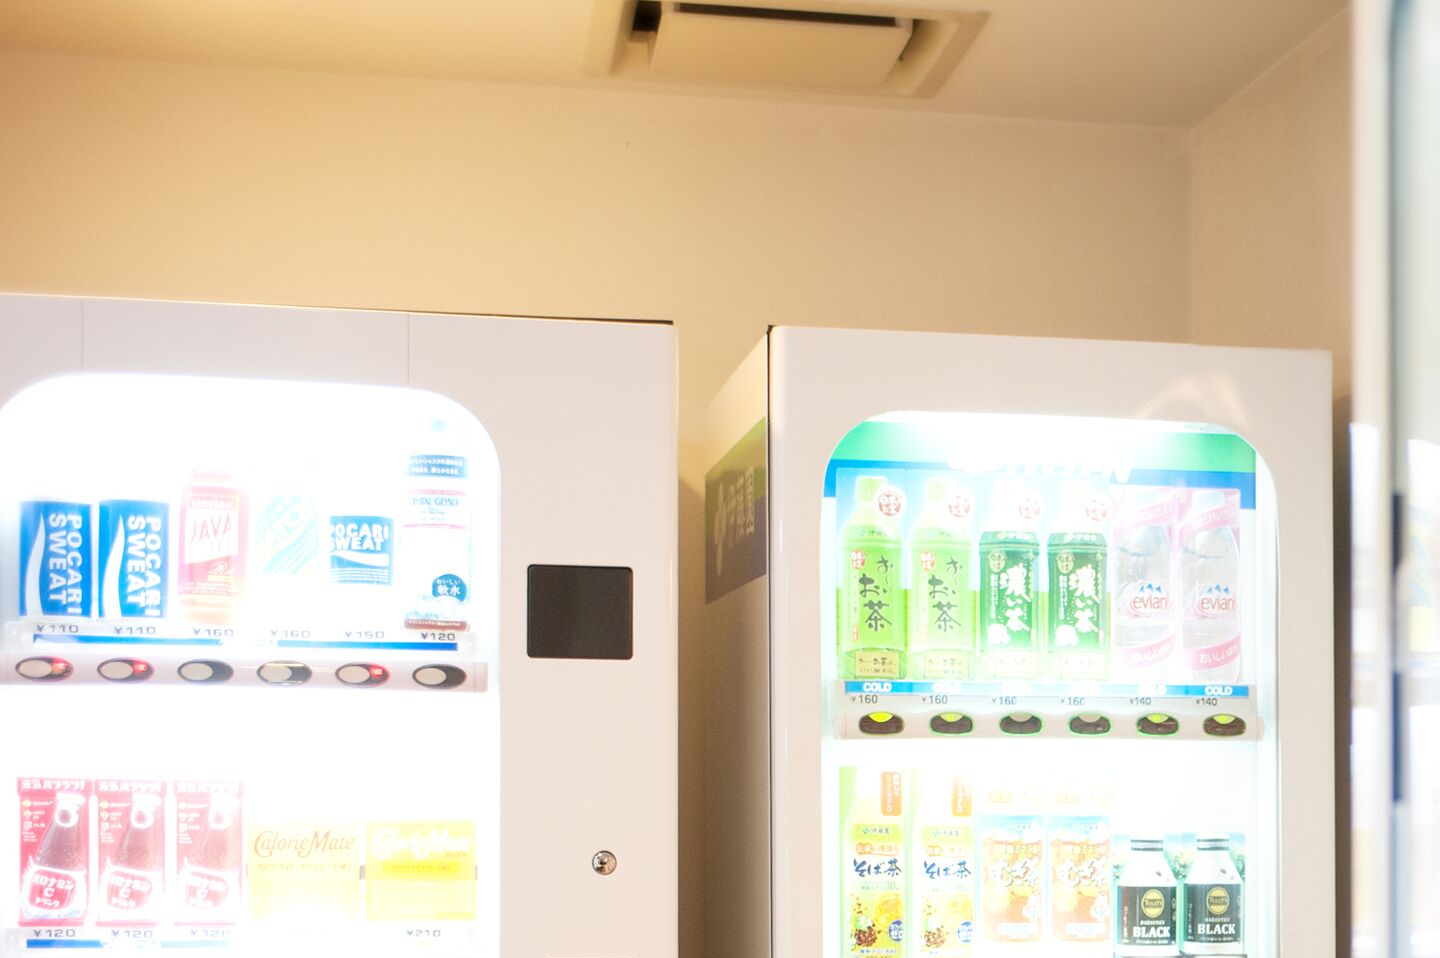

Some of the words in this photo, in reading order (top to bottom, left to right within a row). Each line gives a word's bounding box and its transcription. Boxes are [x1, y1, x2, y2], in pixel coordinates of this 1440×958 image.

[190, 513, 232, 543] JAVA
[49, 513, 67, 605] SWEAT
[66, 514, 82, 614] POCARI
[127, 515, 146, 607] SWEAT
[145, 516, 161, 617] POCARI
[1133, 595, 1167, 610] evian
[1200, 595, 1235, 611] evian
[36, 624, 79, 633] ¥110
[113, 626, 157, 635] ¥110
[420, 632, 456, 641] ¥120
[863, 682, 893, 693] COLD
[1204, 686, 1233, 696] COLD
[851, 694, 878, 704] ¥160
[921, 695, 948, 705] ¥160
[1129, 697, 1152, 706] ¥140
[1195, 698, 1218, 707] ¥140
[853, 858, 903, 878] そば茶
[923, 860, 972, 879] そば茶
[43, 889, 54, 897] C
[33, 929, 76, 938] ¥120
[406, 929, 442, 938] ¥210
[1133, 926, 1171, 938] BLACK
[1197, 923, 1236, 935] BLACK
[111, 930, 154, 939] ¥120
